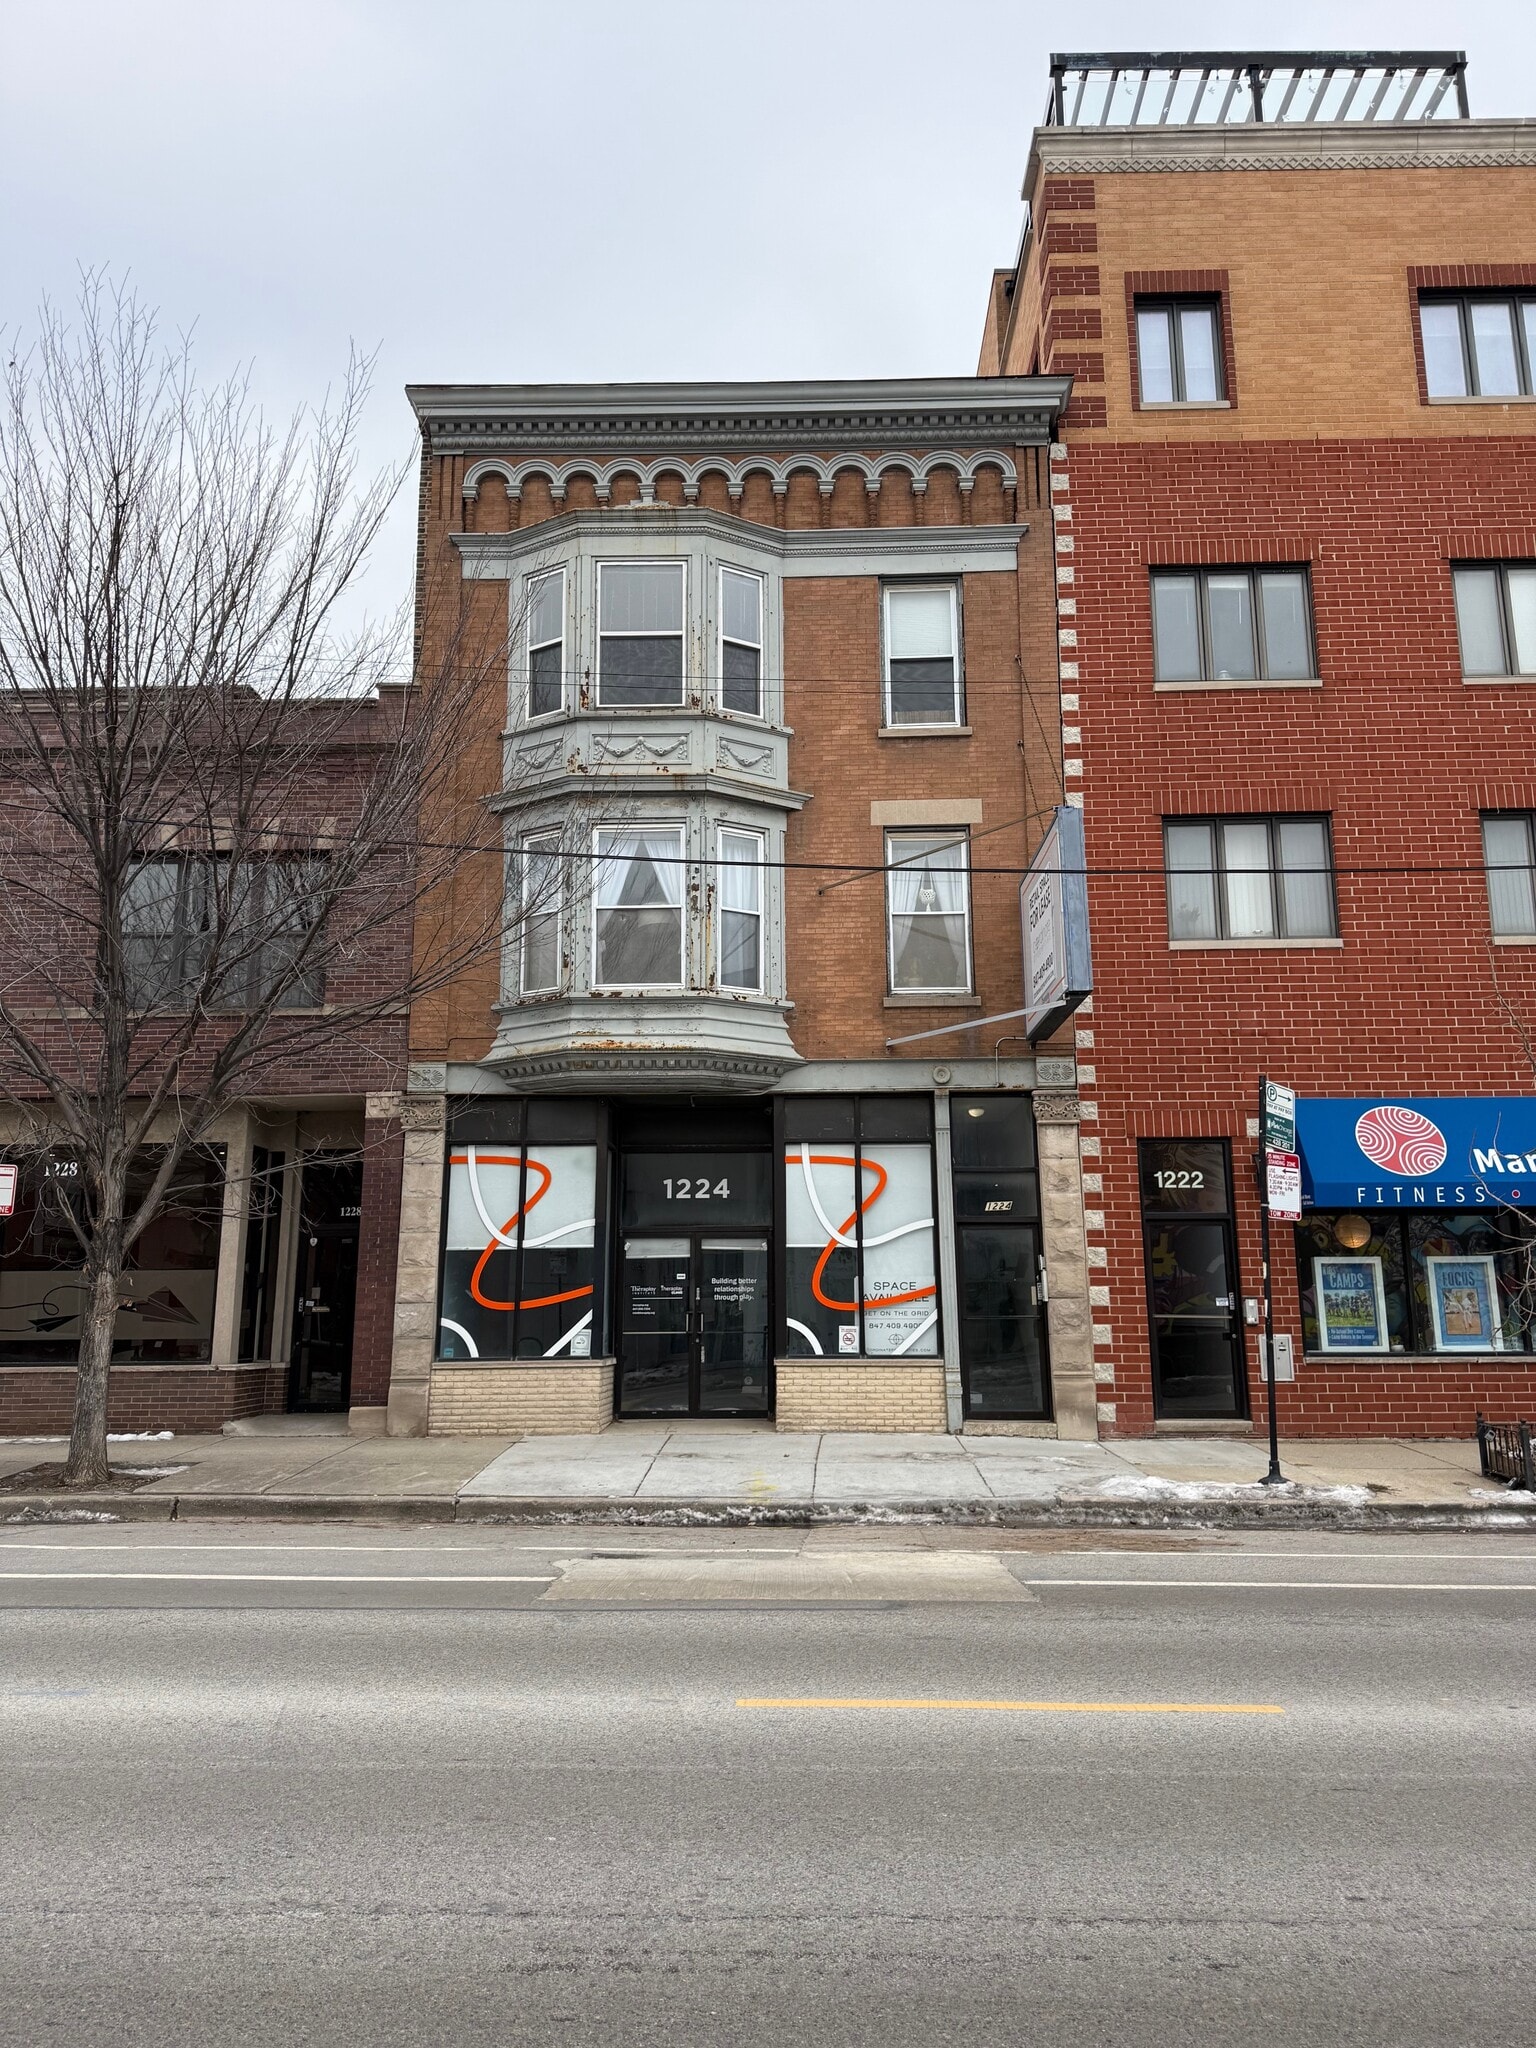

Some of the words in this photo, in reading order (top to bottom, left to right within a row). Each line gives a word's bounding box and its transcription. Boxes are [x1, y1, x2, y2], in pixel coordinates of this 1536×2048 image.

[1029, 906, 1039, 932] FOR
[1039, 886, 1050, 919] LEASE
[44, 1162, 78, 1177] 1228
[1154, 1171, 1205, 1189] 1222
[663, 1178, 730, 1199] 1224
[1357, 1186, 1486, 1203] FITNESS
[340, 1207, 362, 1216] 1228
[987, 1202, 1012, 1211] 1224
[1283, 1211, 1298, 1219] ZONE
[711, 1277, 737, 1285] Building
[1330, 1273, 1364, 1288] CAMPS
[1442, 1271, 1475, 1287] FOCUS
[714, 1285, 754, 1293] relationships
[873, 1281, 917, 1291] SPACE
[863, 1293, 929, 1303] AVAILE
